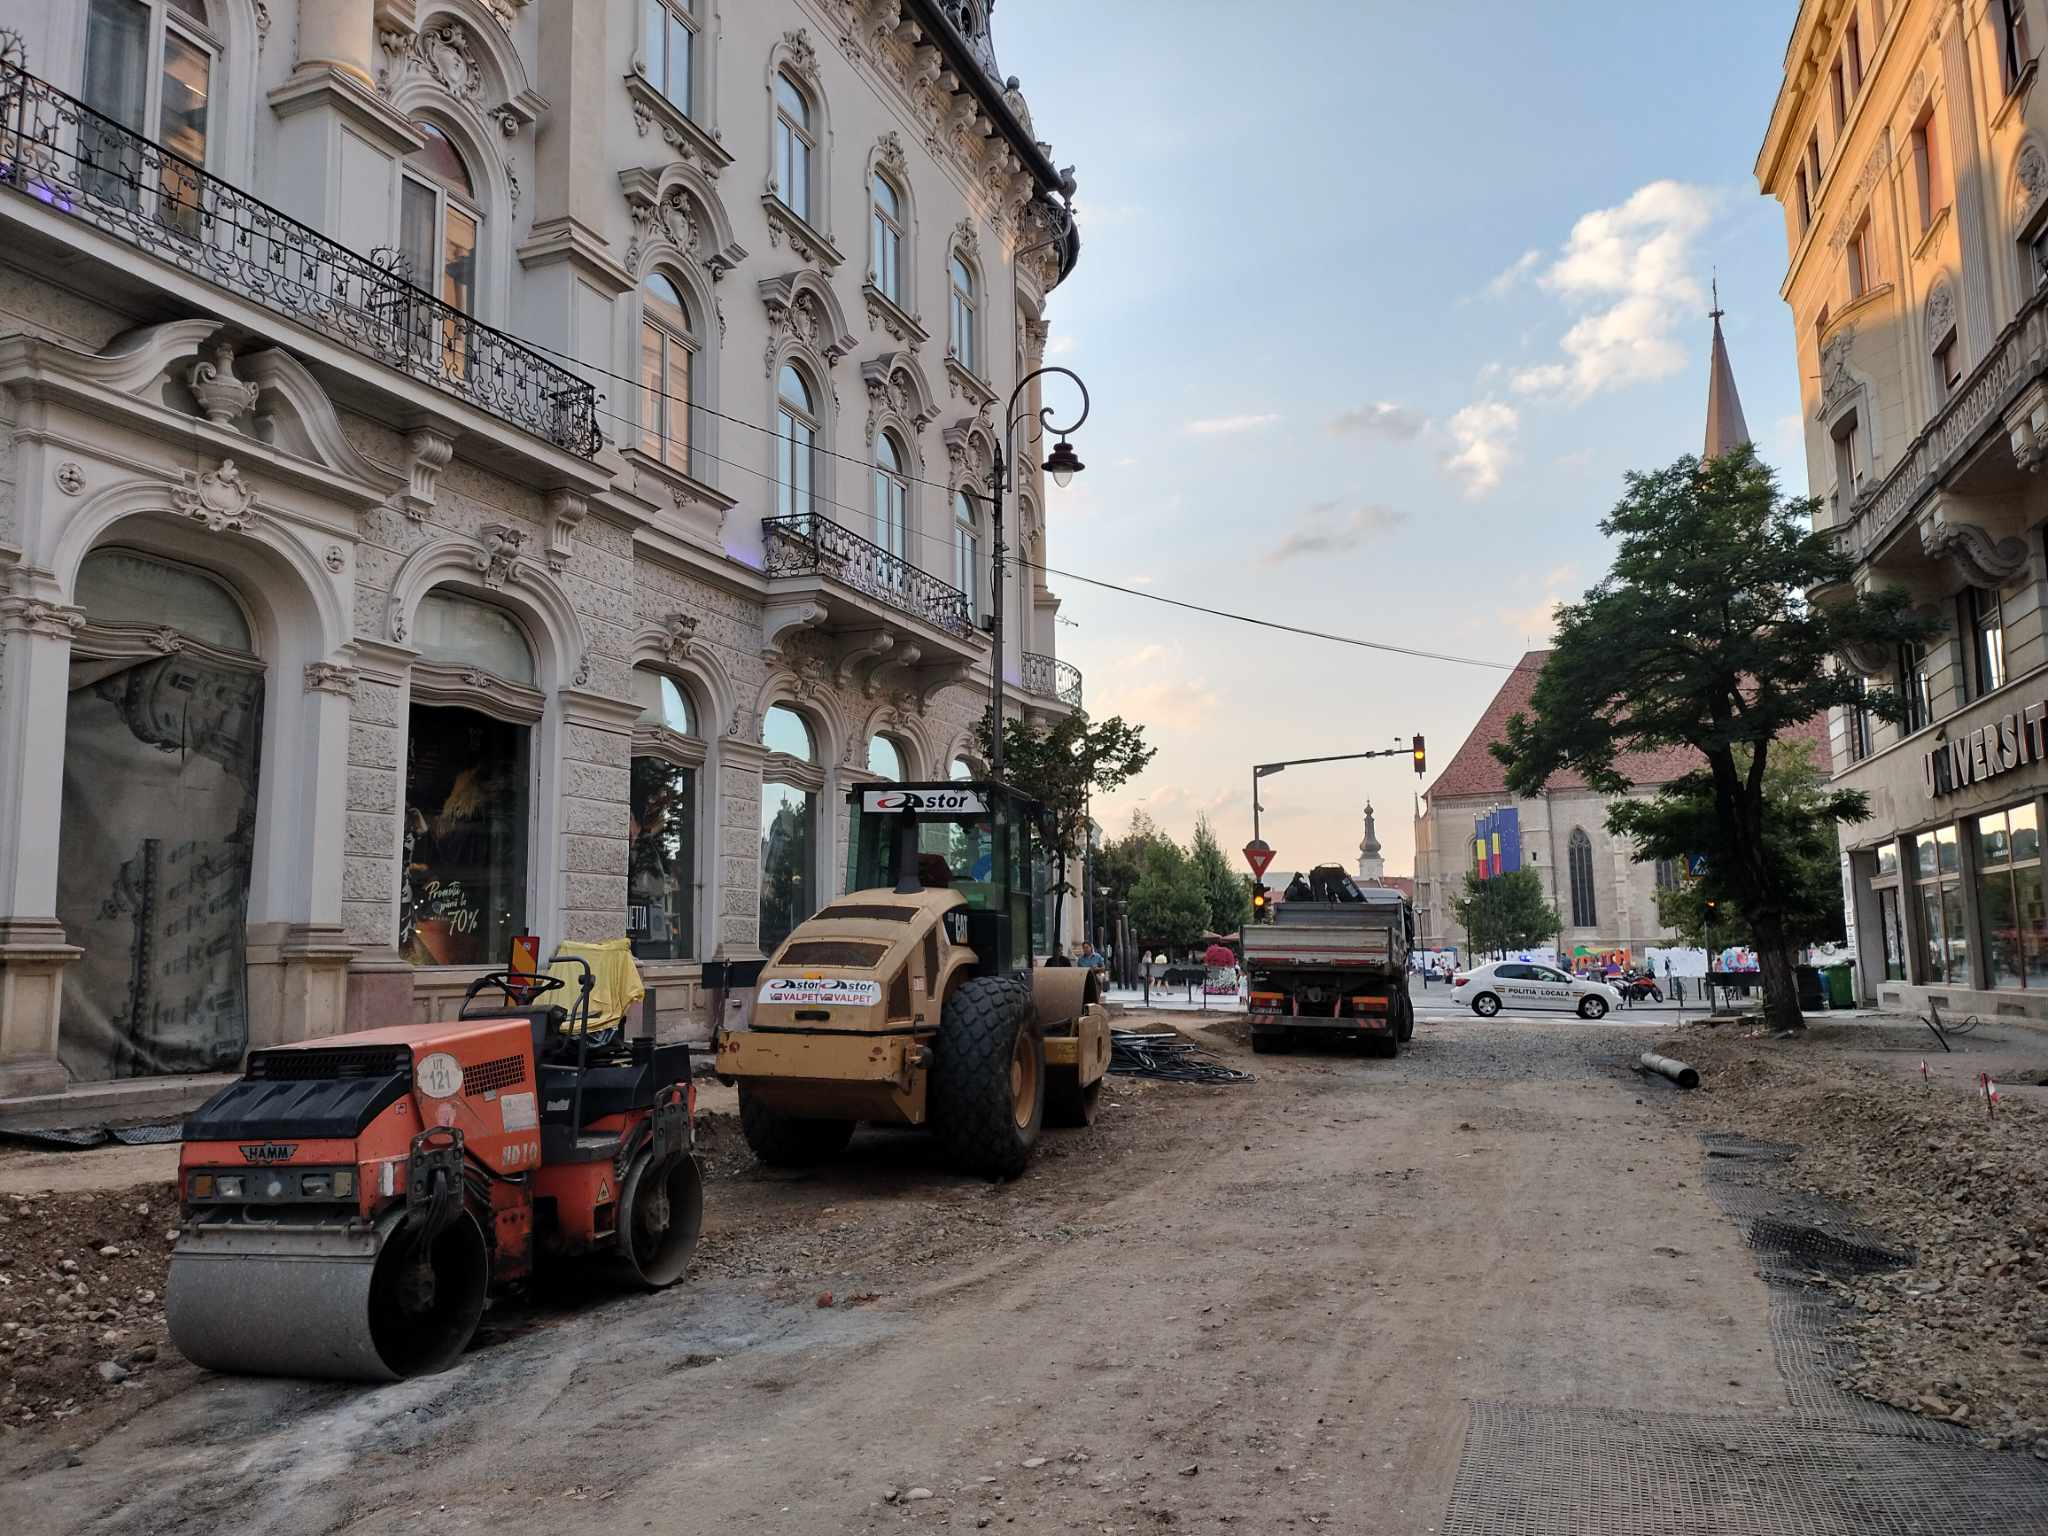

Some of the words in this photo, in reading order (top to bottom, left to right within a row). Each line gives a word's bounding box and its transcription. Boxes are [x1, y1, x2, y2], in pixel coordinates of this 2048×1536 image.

[448, 908, 480, 936] 70%
[430, 1069, 451, 1090] 121
[249, 1146, 289, 1159] HAMM
